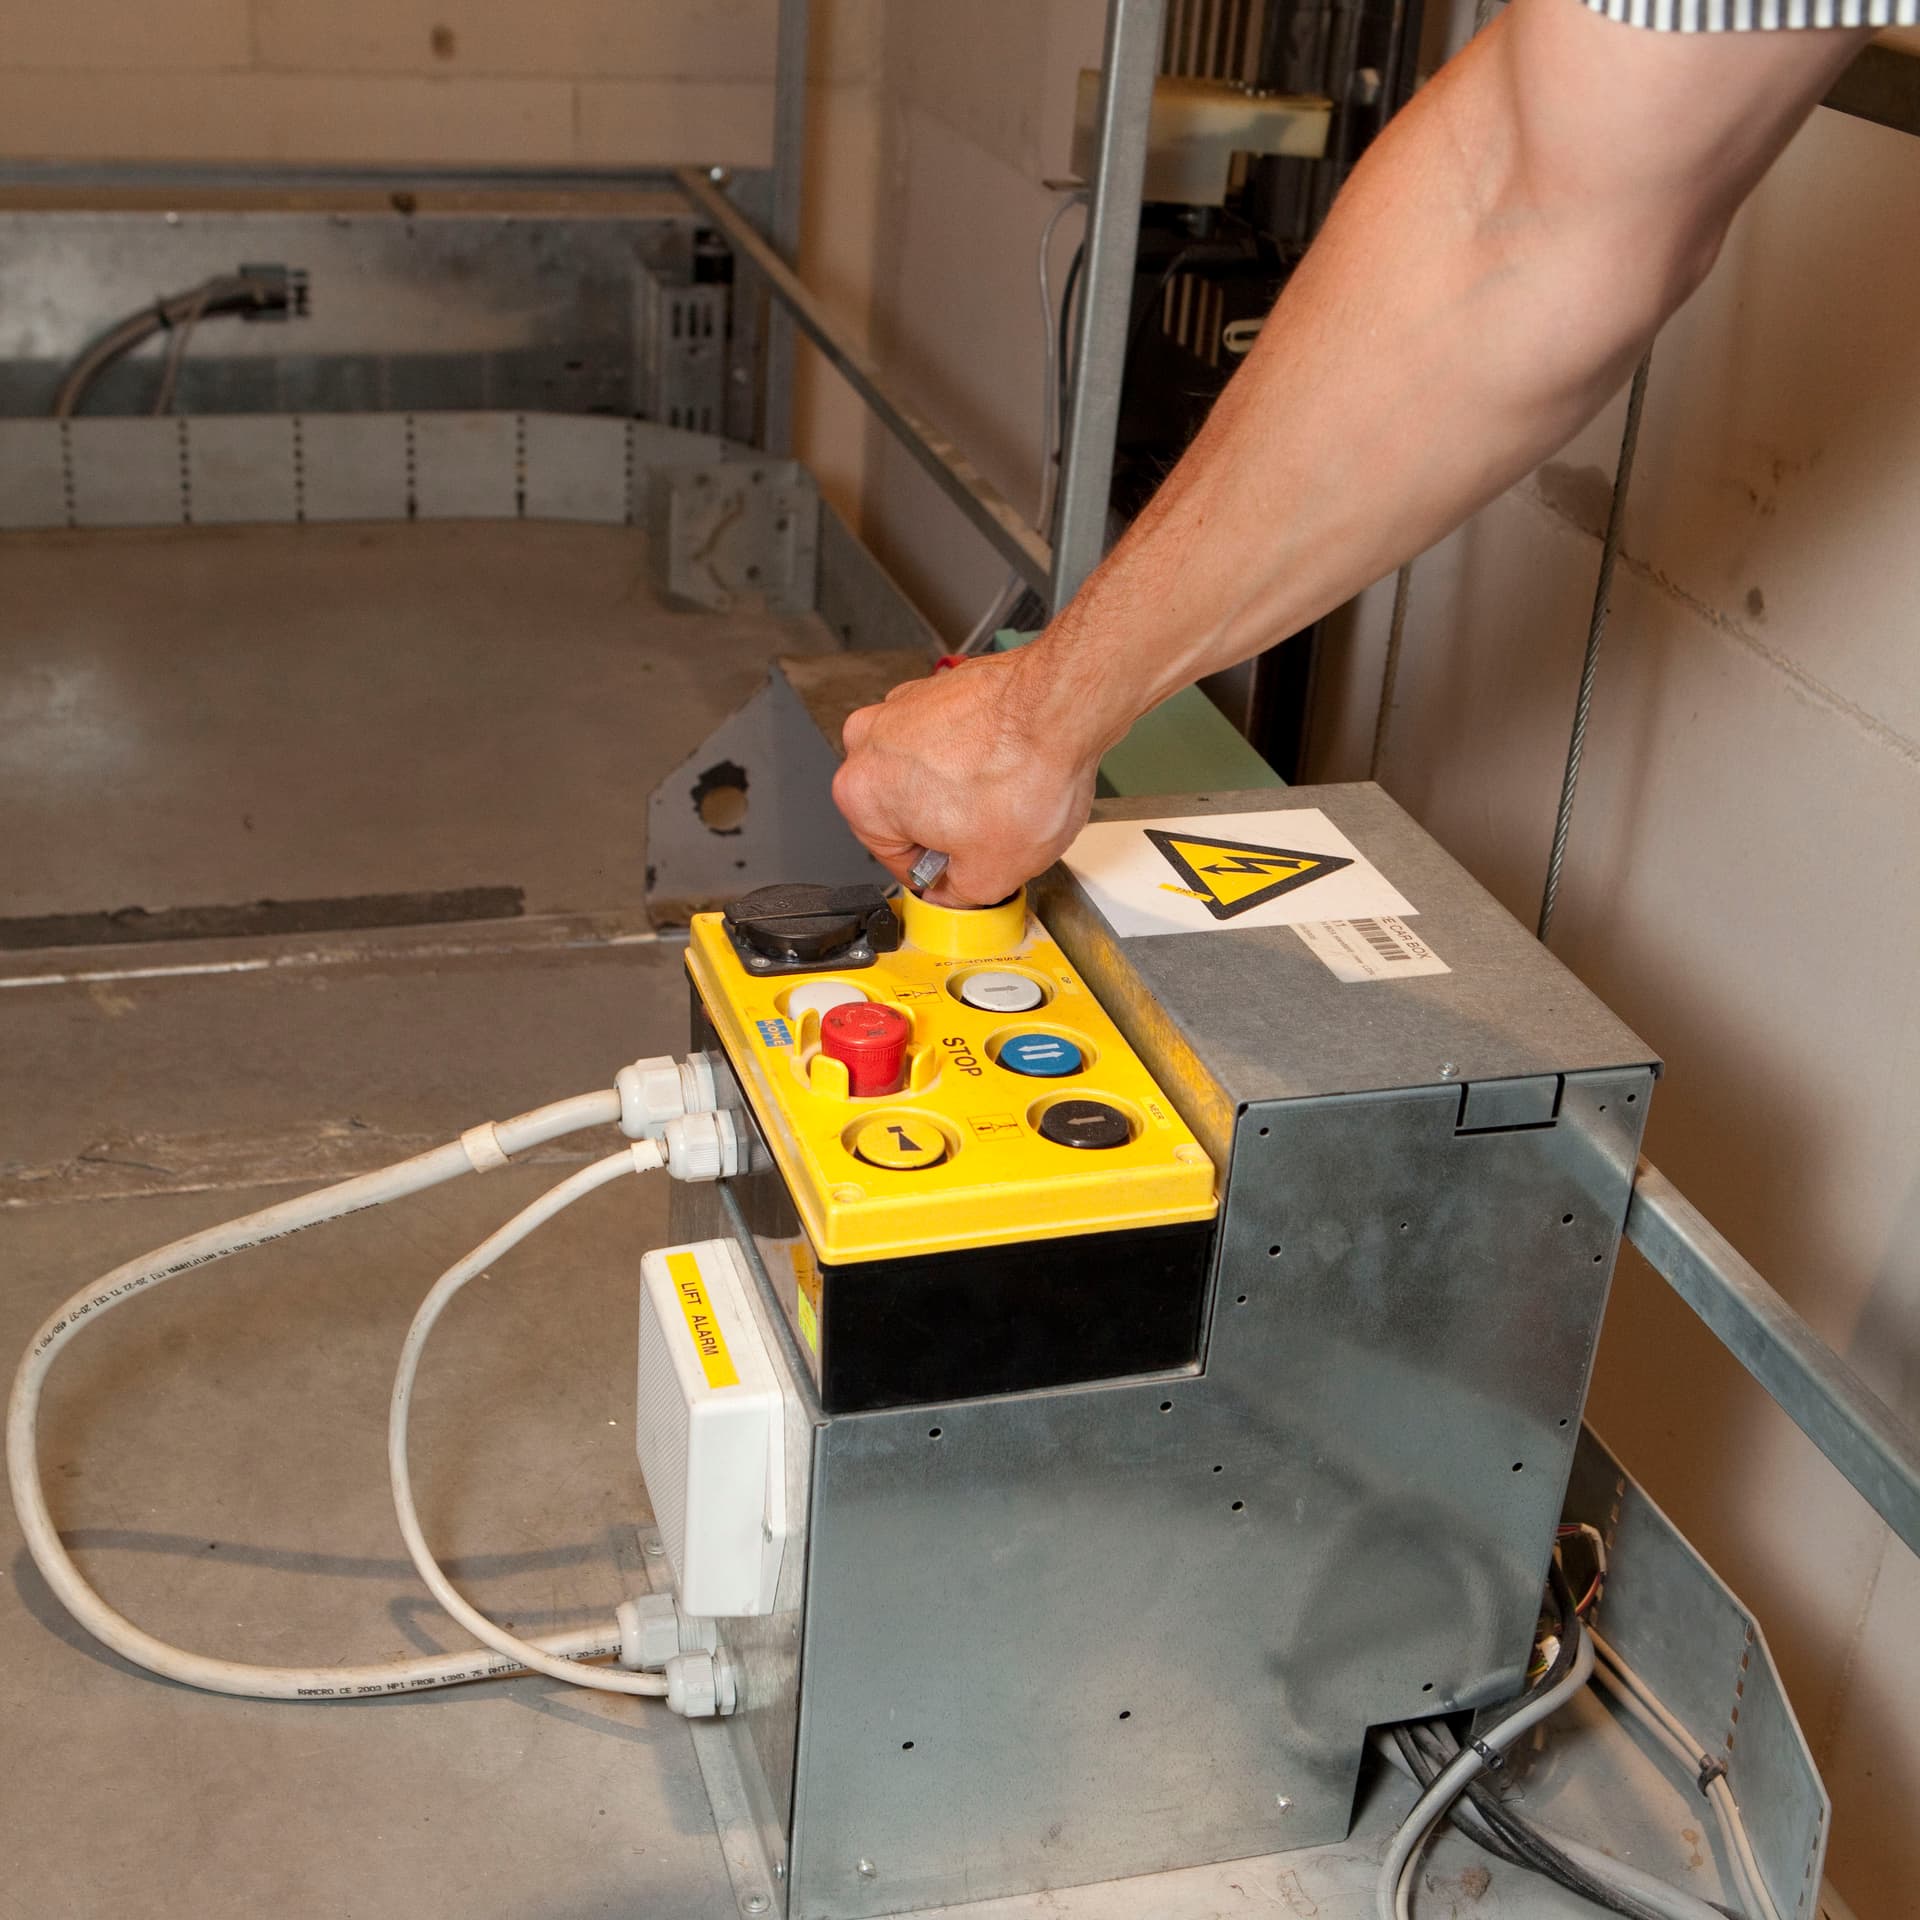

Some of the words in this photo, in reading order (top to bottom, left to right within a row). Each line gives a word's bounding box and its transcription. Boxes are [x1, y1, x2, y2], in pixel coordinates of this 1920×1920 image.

[1390, 925, 1413, 941] CAR
[1406, 942, 1432, 959] BOX
[942, 1037, 983, 1076] STOP
[681, 1282, 702, 1305] LIFT
[692, 1315, 719, 1356] ALARM
[297, 1688, 334, 1696] RAMCRO
[357, 1685, 382, 1693] 2003
[411, 1678, 435, 1687] FROR
